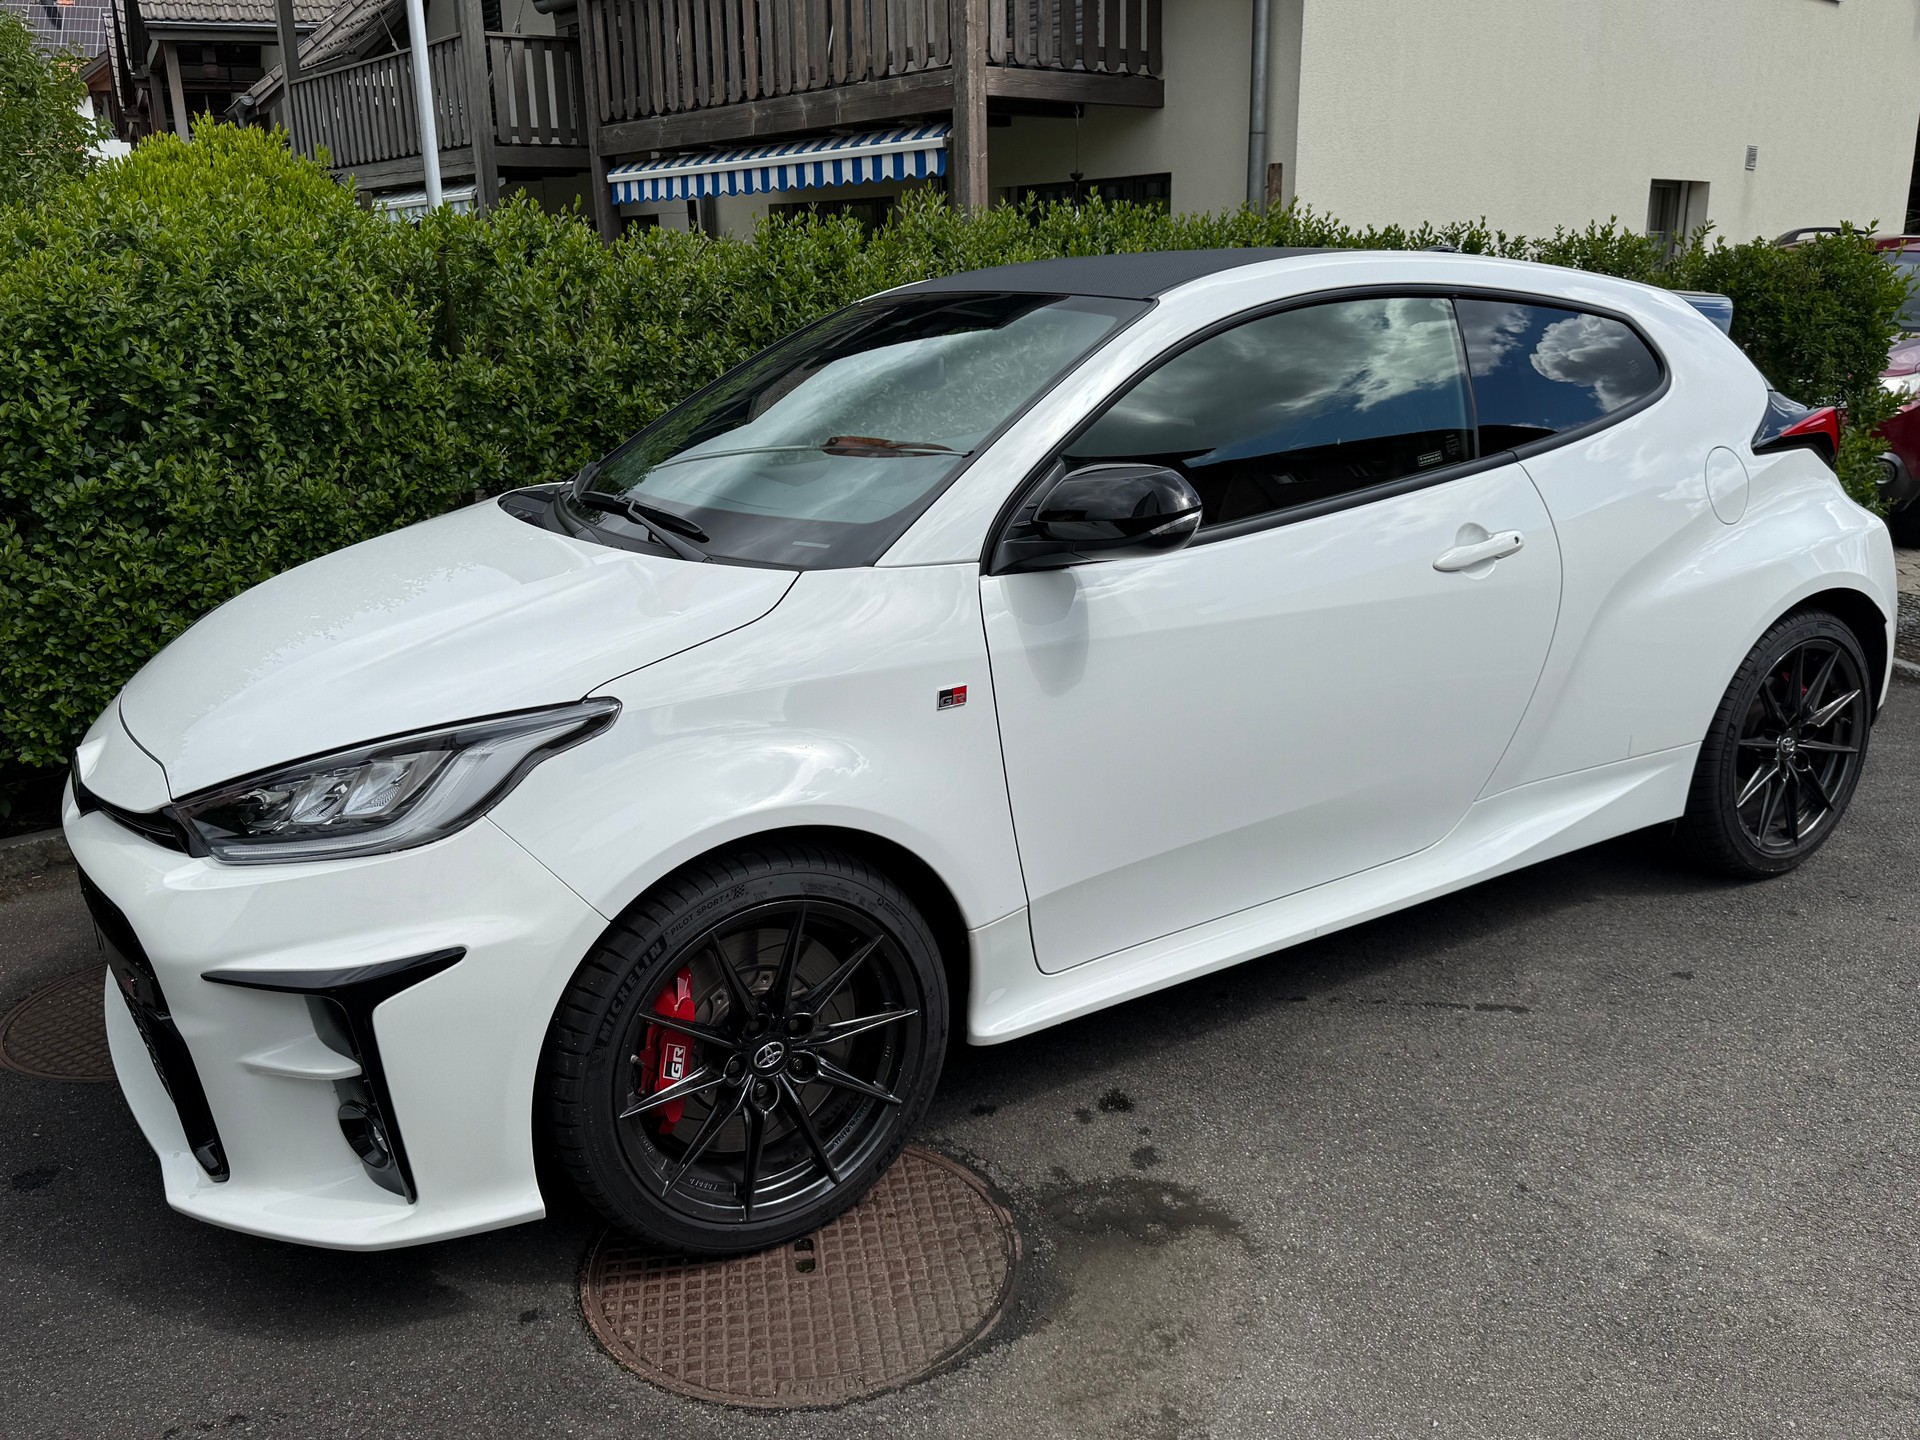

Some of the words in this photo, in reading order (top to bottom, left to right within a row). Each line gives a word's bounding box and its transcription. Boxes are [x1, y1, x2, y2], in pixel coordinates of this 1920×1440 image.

[939, 692, 966, 707] GR
[670, 913, 693, 935] PILOT
[696, 895, 725, 916] SPORT
[595, 935, 669, 1047] MICHELIN
[671, 1046, 684, 1078] GR
